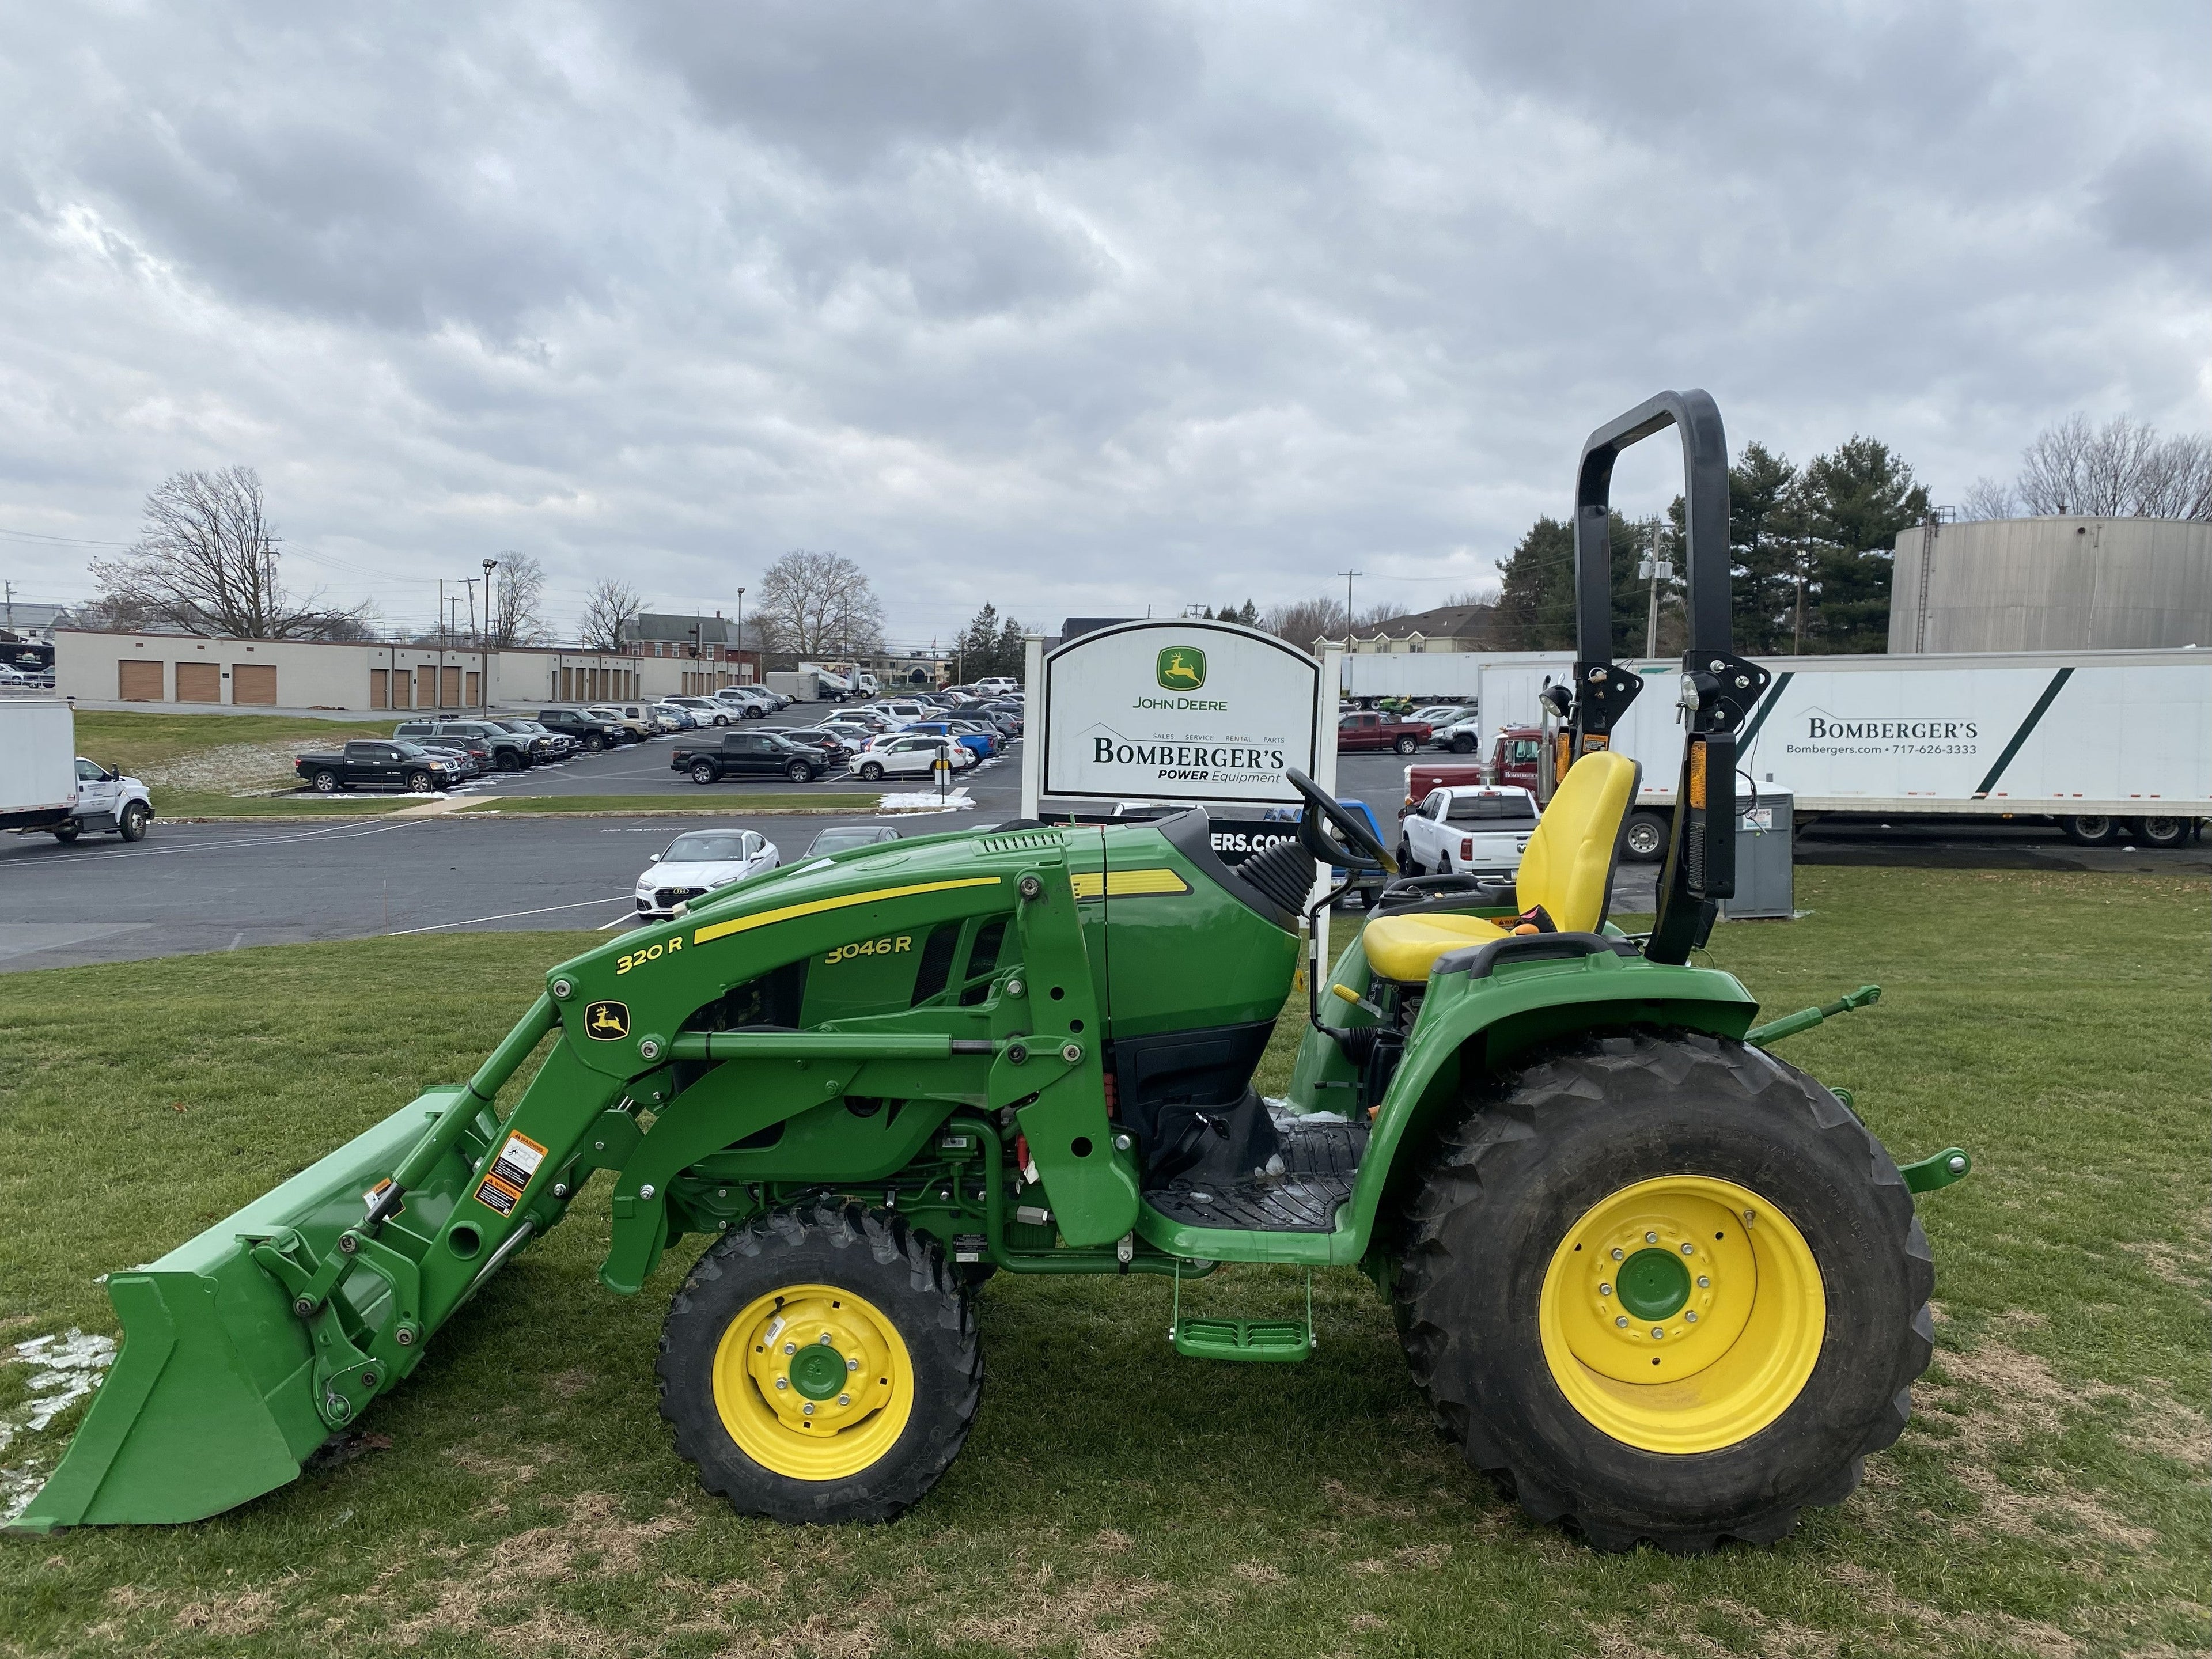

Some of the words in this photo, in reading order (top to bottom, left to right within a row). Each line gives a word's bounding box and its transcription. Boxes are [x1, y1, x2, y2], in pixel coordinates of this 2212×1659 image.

[1132, 696, 1174, 710] JOHN
[1177, 698, 1228, 711] DEERE
[1809, 717, 1978, 739] BOMBERGER'S
[1093, 737, 1285, 769] BOMBERGER'S
[1787, 744, 1881, 756] Bombergers.com
[1892, 744, 1977, 755] 717-626-3333
[1158, 769, 1209, 781] POWER
[1211, 770, 1281, 784] Equipment
[521, 1137, 544, 1152] WARNING
[494, 1181, 517, 1197] WARNING
